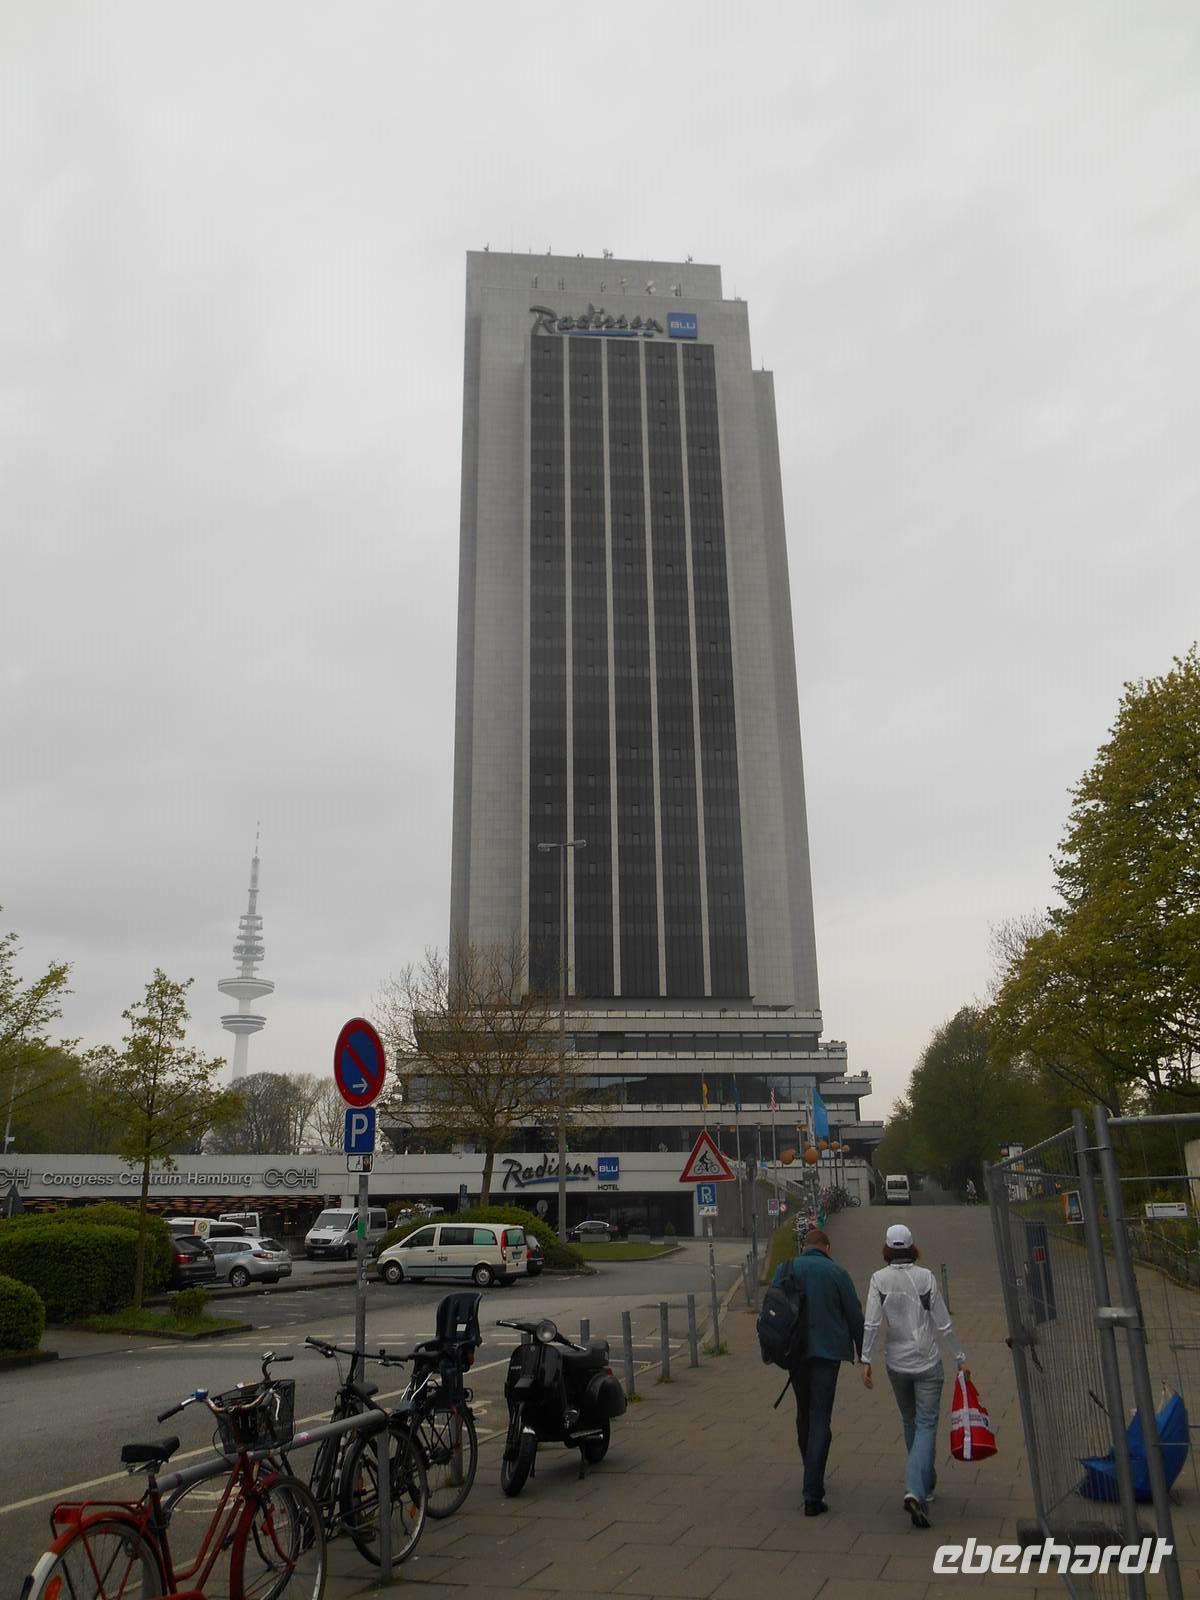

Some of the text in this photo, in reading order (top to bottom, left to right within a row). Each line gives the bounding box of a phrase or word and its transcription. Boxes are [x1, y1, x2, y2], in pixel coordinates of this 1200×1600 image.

[351, 1113, 369, 1148] P
[41, 1171, 113, 1187] Congress
[187, 1171, 253, 1187] Hamburg
[263, 1167, 320, 1189] CCH
